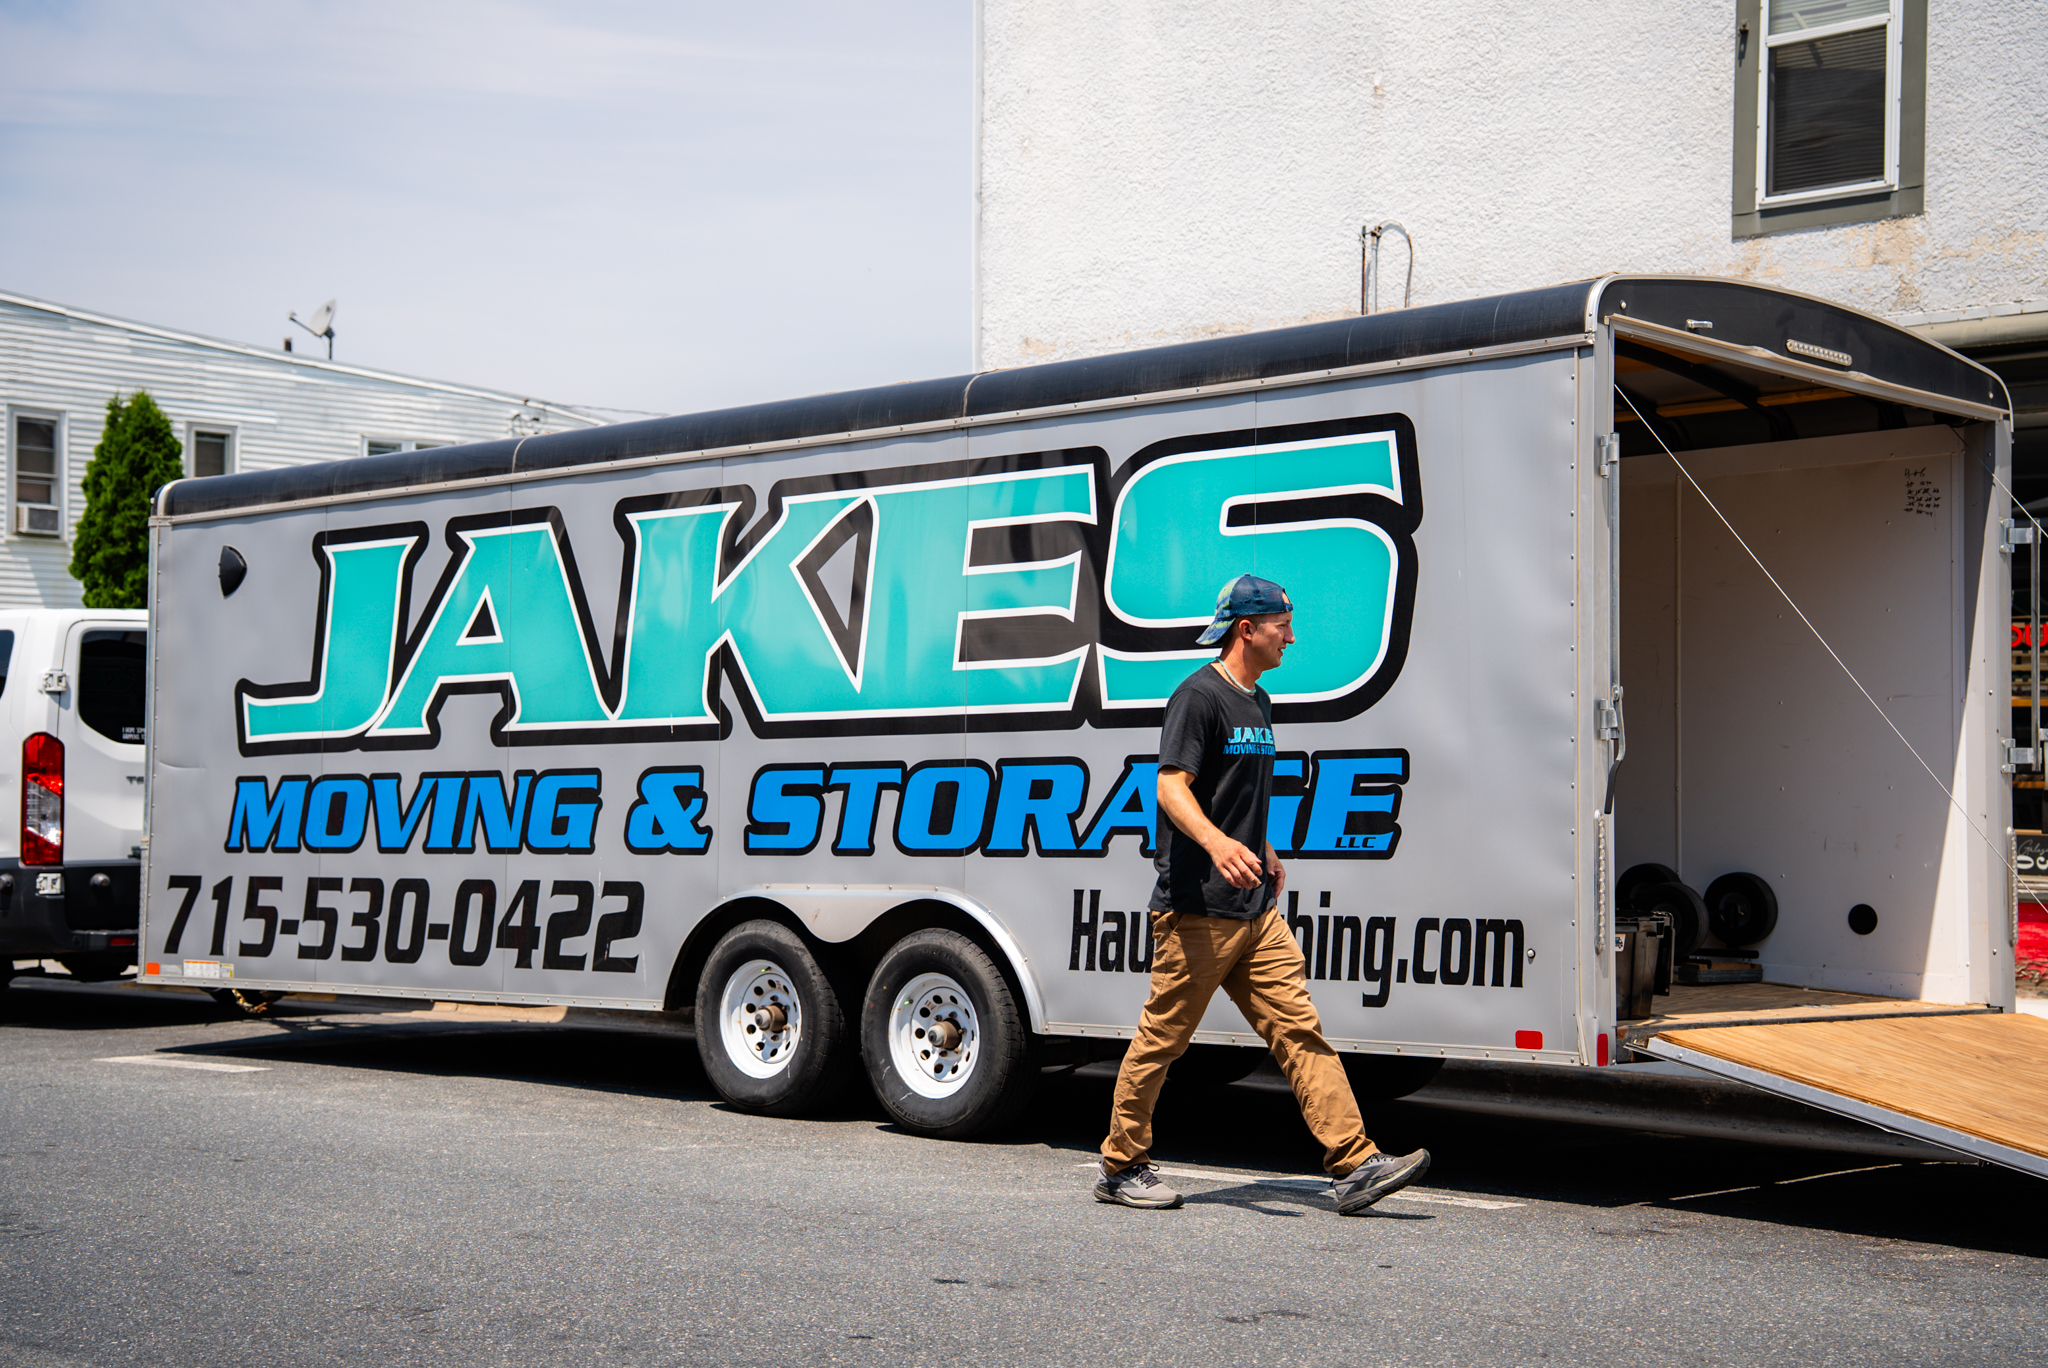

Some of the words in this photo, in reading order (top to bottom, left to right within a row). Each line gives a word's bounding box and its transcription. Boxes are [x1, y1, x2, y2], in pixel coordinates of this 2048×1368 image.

[236, 414, 1416, 754] JAKES
[1227, 726, 1274, 745] JAKE
[225, 768, 602, 854] MOVING
[624, 765, 712, 855] &
[1334, 836, 1377, 849] LLC
[164, 875, 645, 973] 715-530-0422
[1068, 889, 1524, 1008] Hauhing.com
